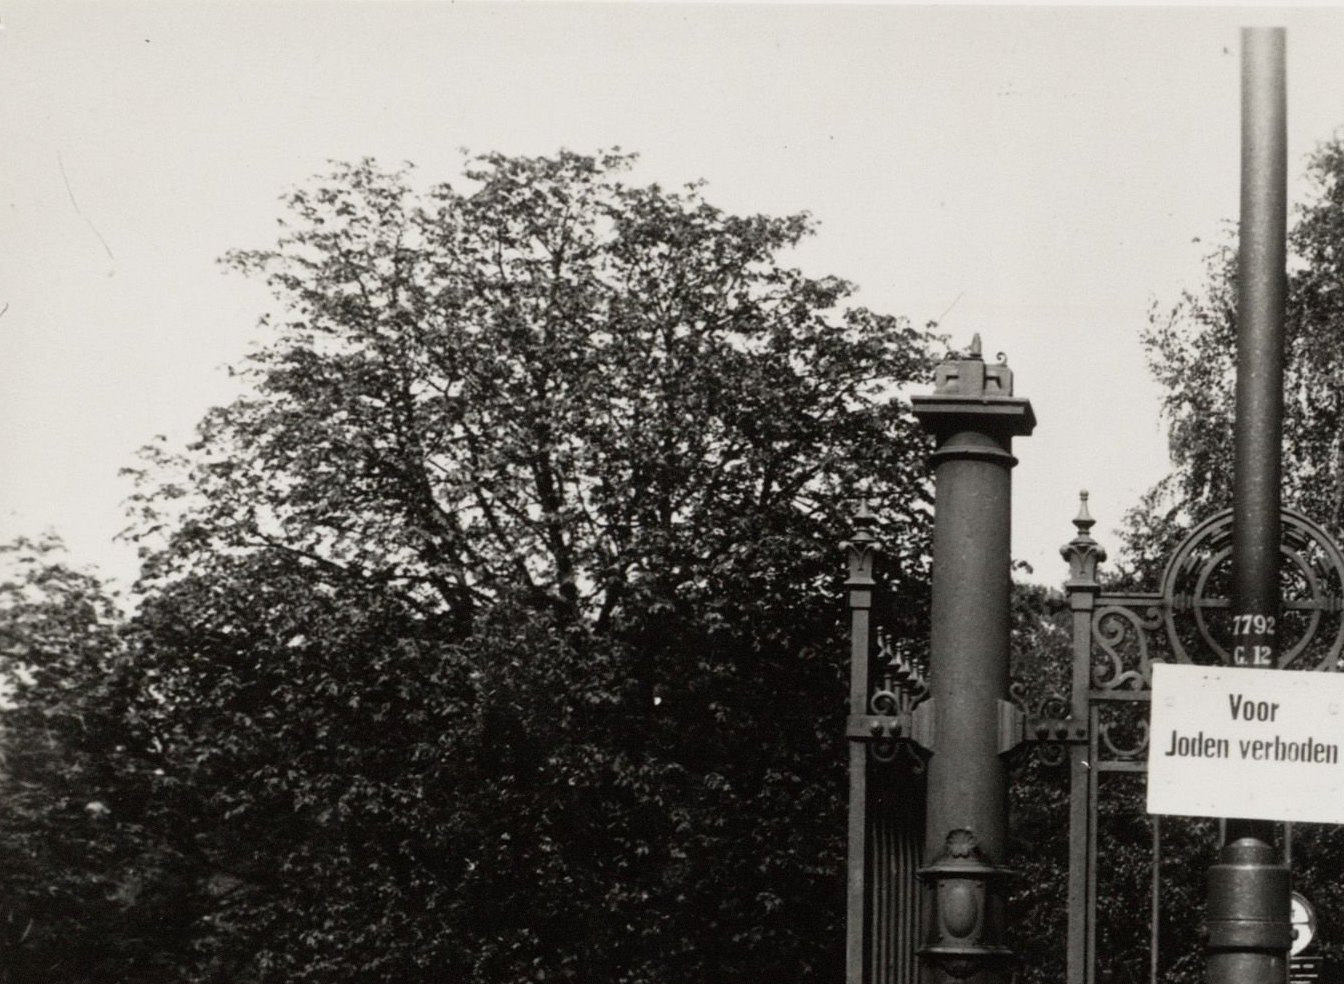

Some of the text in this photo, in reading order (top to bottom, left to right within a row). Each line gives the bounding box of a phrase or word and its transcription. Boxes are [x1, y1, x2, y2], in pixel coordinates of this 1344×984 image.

[1232, 614, 1276, 636] 1792
[1252, 645, 1272, 665] 12
[1229, 693, 1280, 722] Voor
[1165, 730, 1339, 764] Joden verboden
